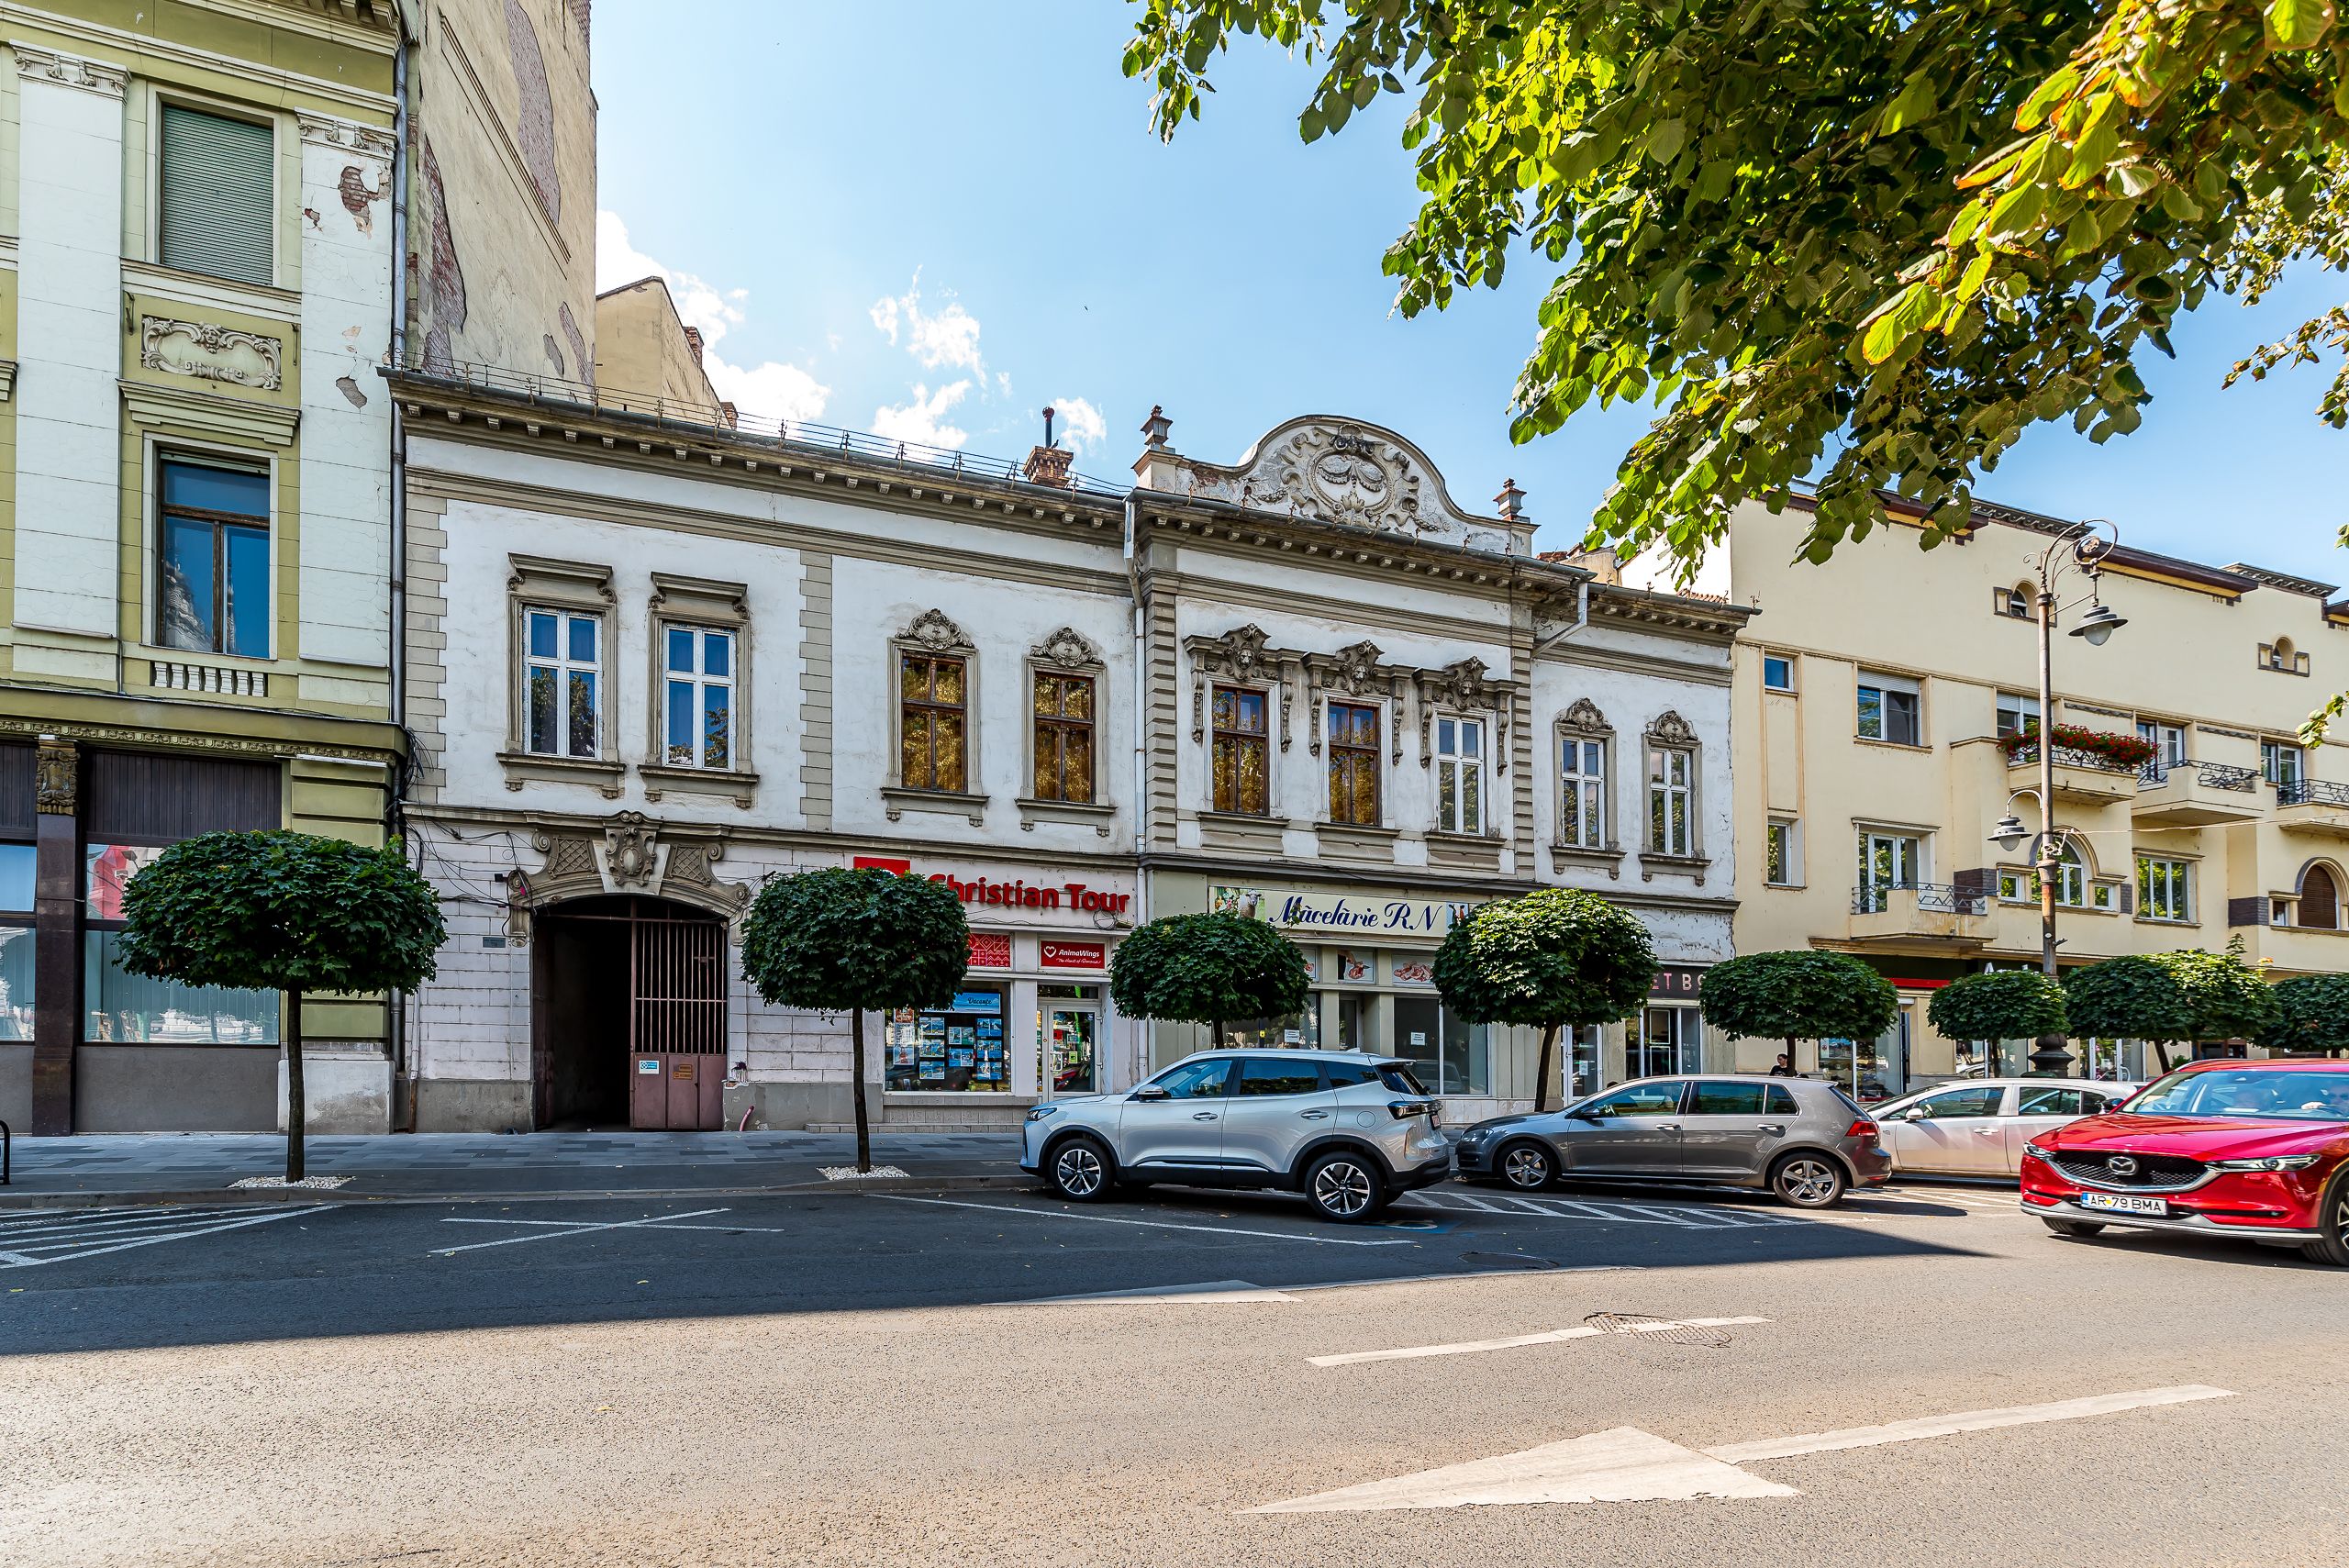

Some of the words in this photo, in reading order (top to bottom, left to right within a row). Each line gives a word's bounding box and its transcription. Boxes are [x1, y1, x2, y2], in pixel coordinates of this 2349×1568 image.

[1064, 884, 1130, 913] Tour
[1058, 949, 1099, 958] AnimaWings
[2090, 1195, 2107, 1206] AR
[2111, 1196, 2128, 1208] 79
[2132, 1198, 2162, 1212] BMA
